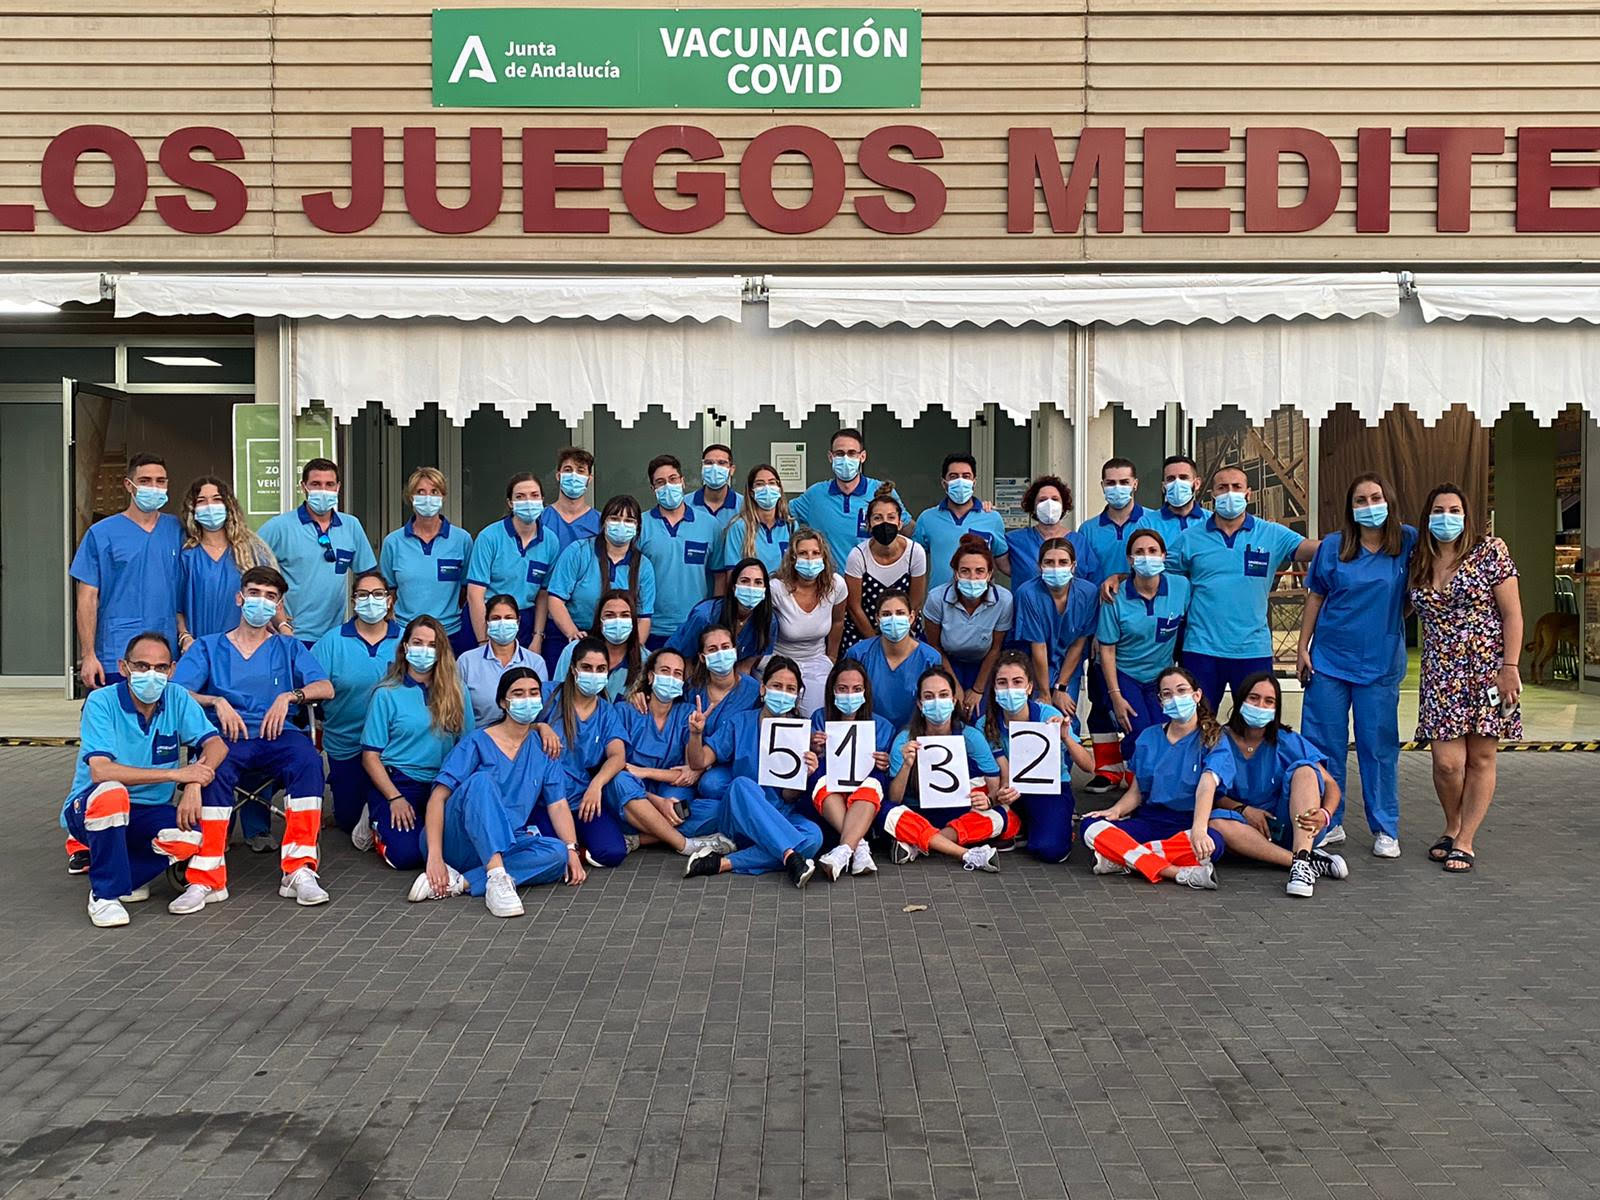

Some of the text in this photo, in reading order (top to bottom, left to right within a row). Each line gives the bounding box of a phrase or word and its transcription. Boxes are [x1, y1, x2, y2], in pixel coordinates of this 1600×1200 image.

[504, 41, 557, 57] Junta
[660, 18, 908, 58] VACUNACIÓN
[504, 60, 621, 79] de Andalucía
[728, 64, 843, 94] COVID
[302, 125, 947, 233] JUEGOS
